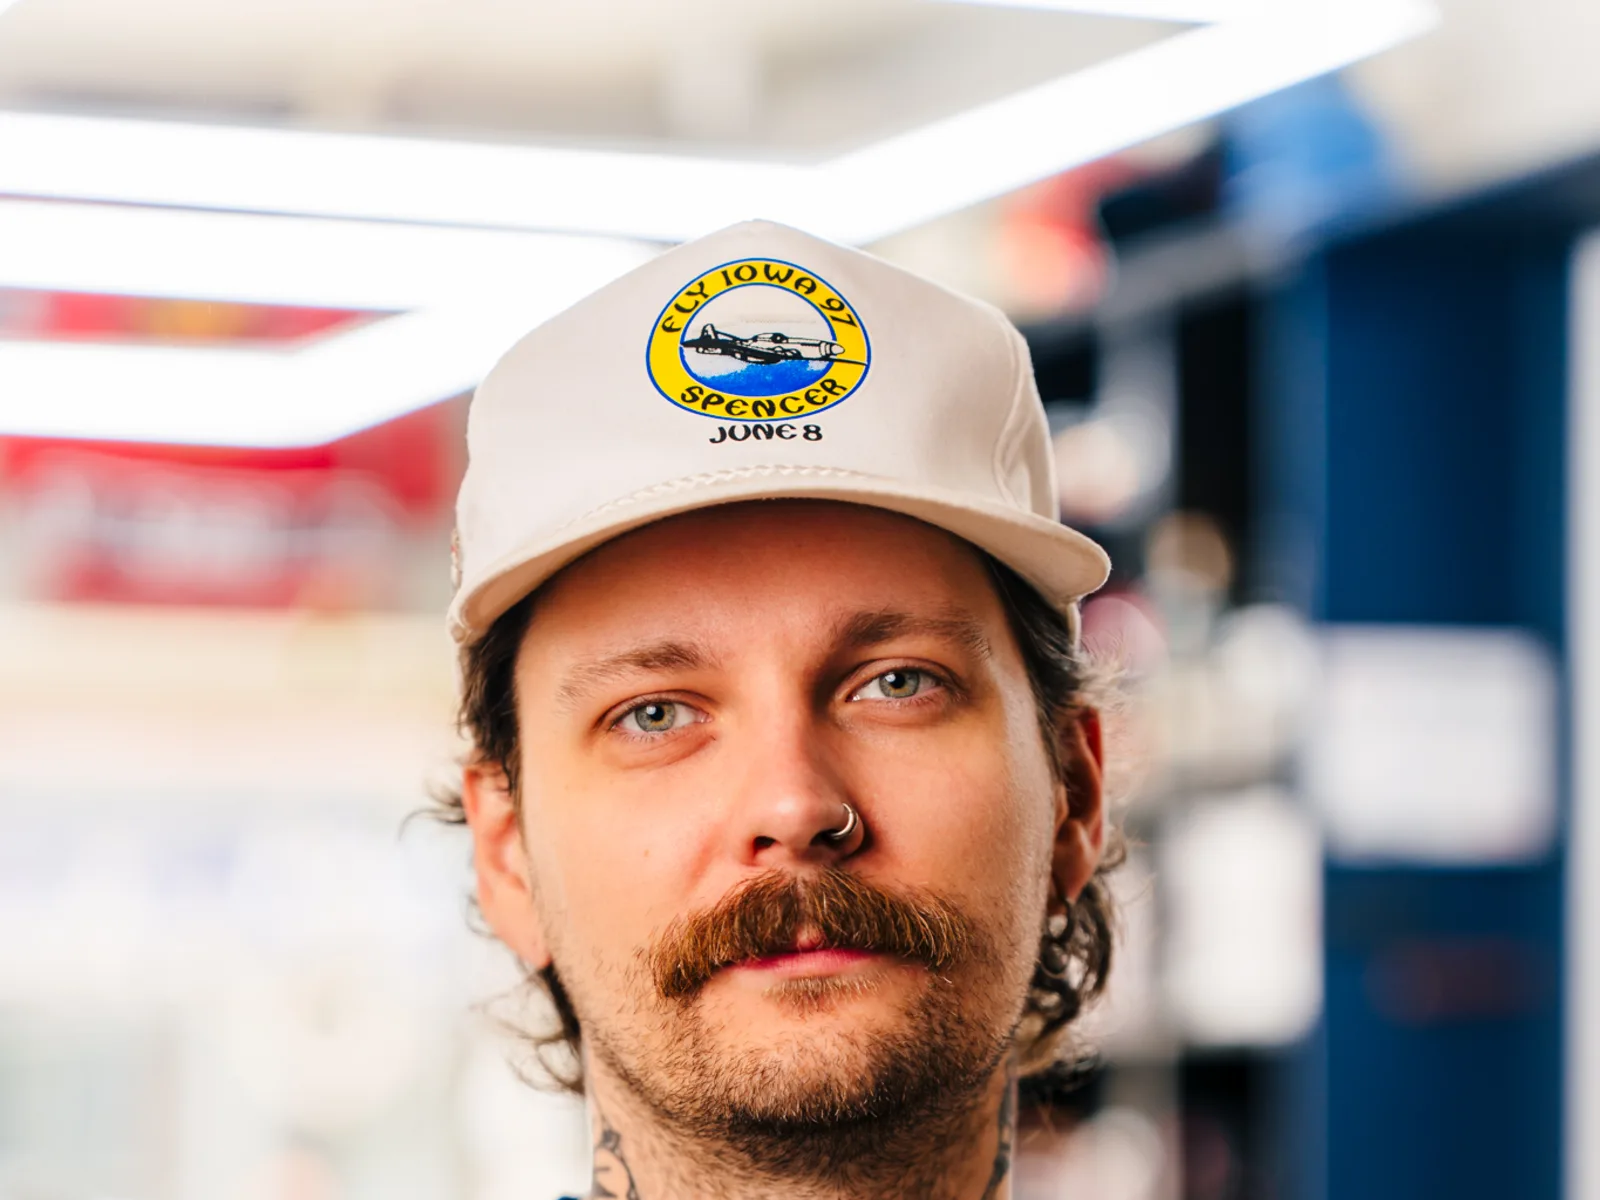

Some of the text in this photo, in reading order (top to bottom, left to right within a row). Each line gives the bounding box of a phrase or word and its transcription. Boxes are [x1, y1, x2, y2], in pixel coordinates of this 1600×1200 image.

[661, 264, 858, 334] FLY IOWA 97
[680, 378, 849, 418] SPENCER
[709, 423, 823, 444] JUNE 8
